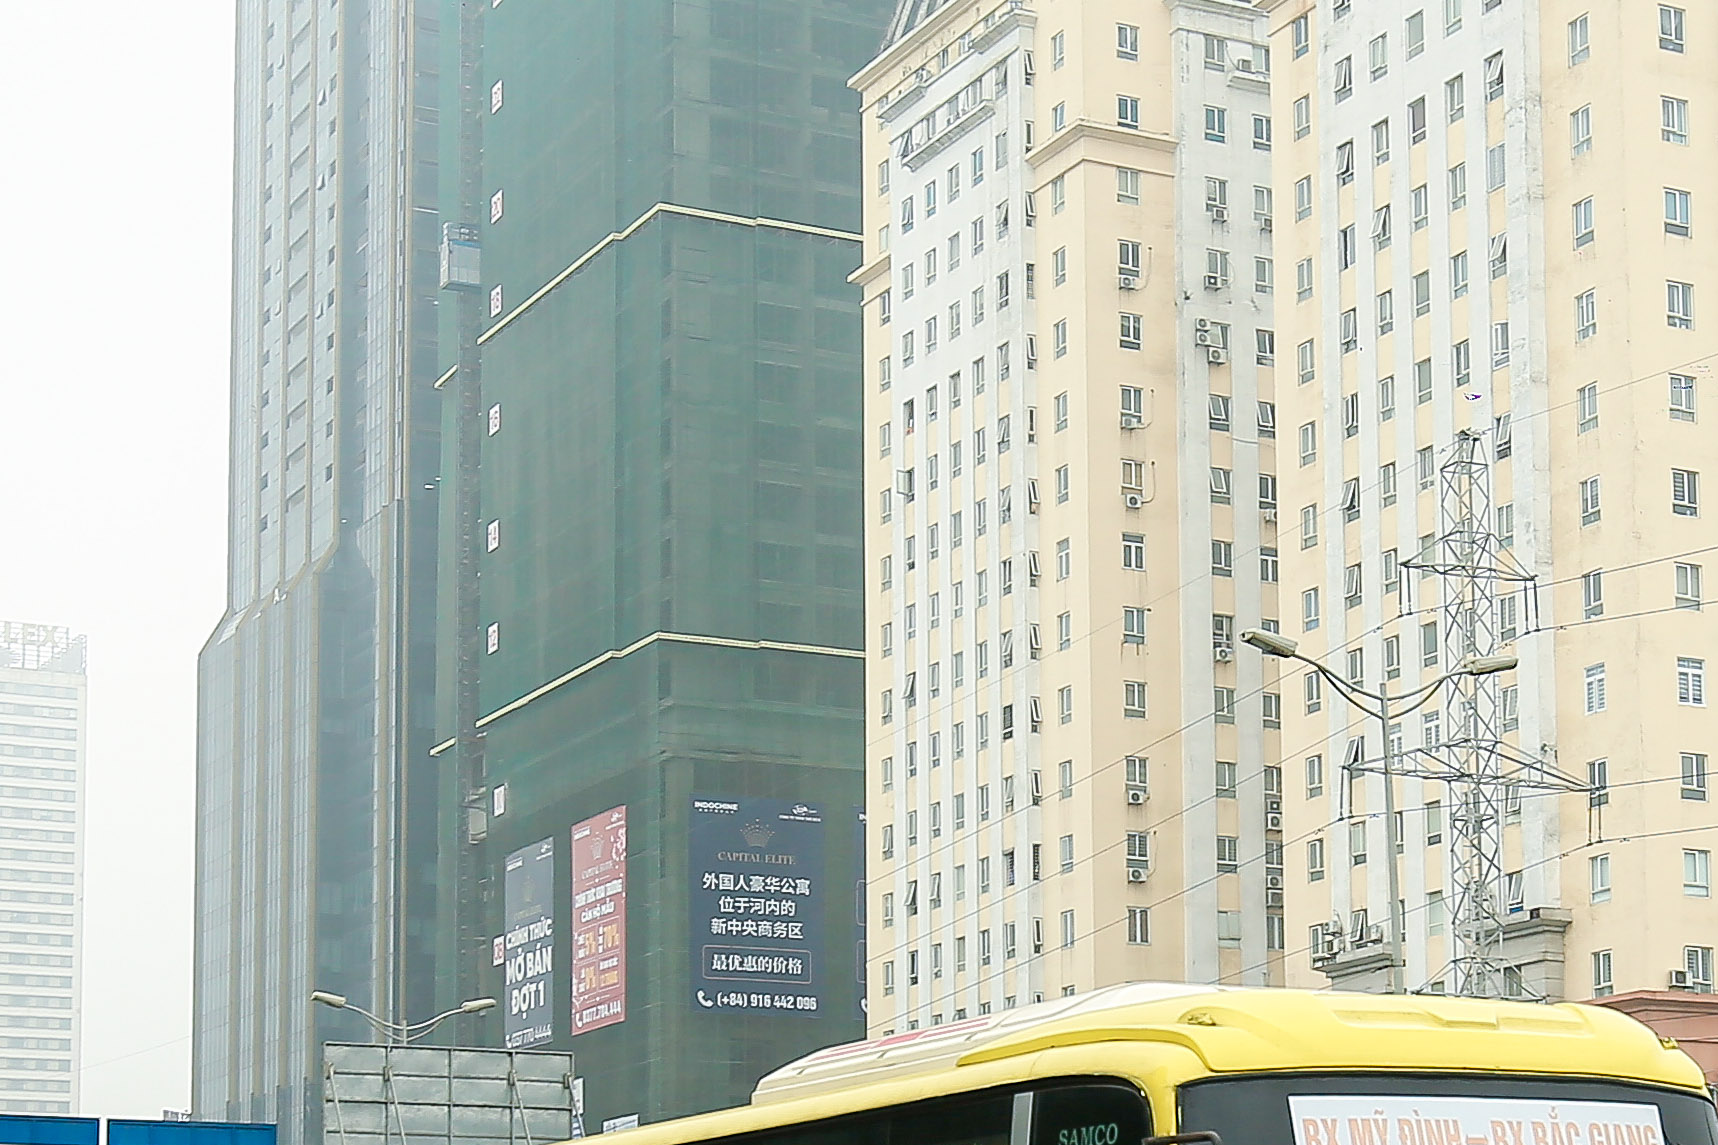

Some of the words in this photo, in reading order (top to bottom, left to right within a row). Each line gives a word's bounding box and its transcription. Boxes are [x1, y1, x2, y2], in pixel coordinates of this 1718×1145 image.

[694, 801, 739, 811] INDOCHINE
[718, 851, 760, 863] CAPITAL
[765, 854, 796, 865] ELITE
[702, 872, 811, 895] 外国人豪华公寓
[719, 896, 796, 916] 位于河内的
[710, 918, 803, 939] 新中央商务区
[506, 948, 525, 986] MỞ
[526, 943, 552, 978] BÁN
[712, 954, 803, 974] 最优惠的价格
[511, 981, 537, 1019] ĐỢT
[537, 979, 545, 1006] 1
[717, 992, 748, 1008] (+84)
[751, 993, 771, 1008] 916
[774, 995, 795, 1009] 442
[796, 996, 818, 1010] 096
